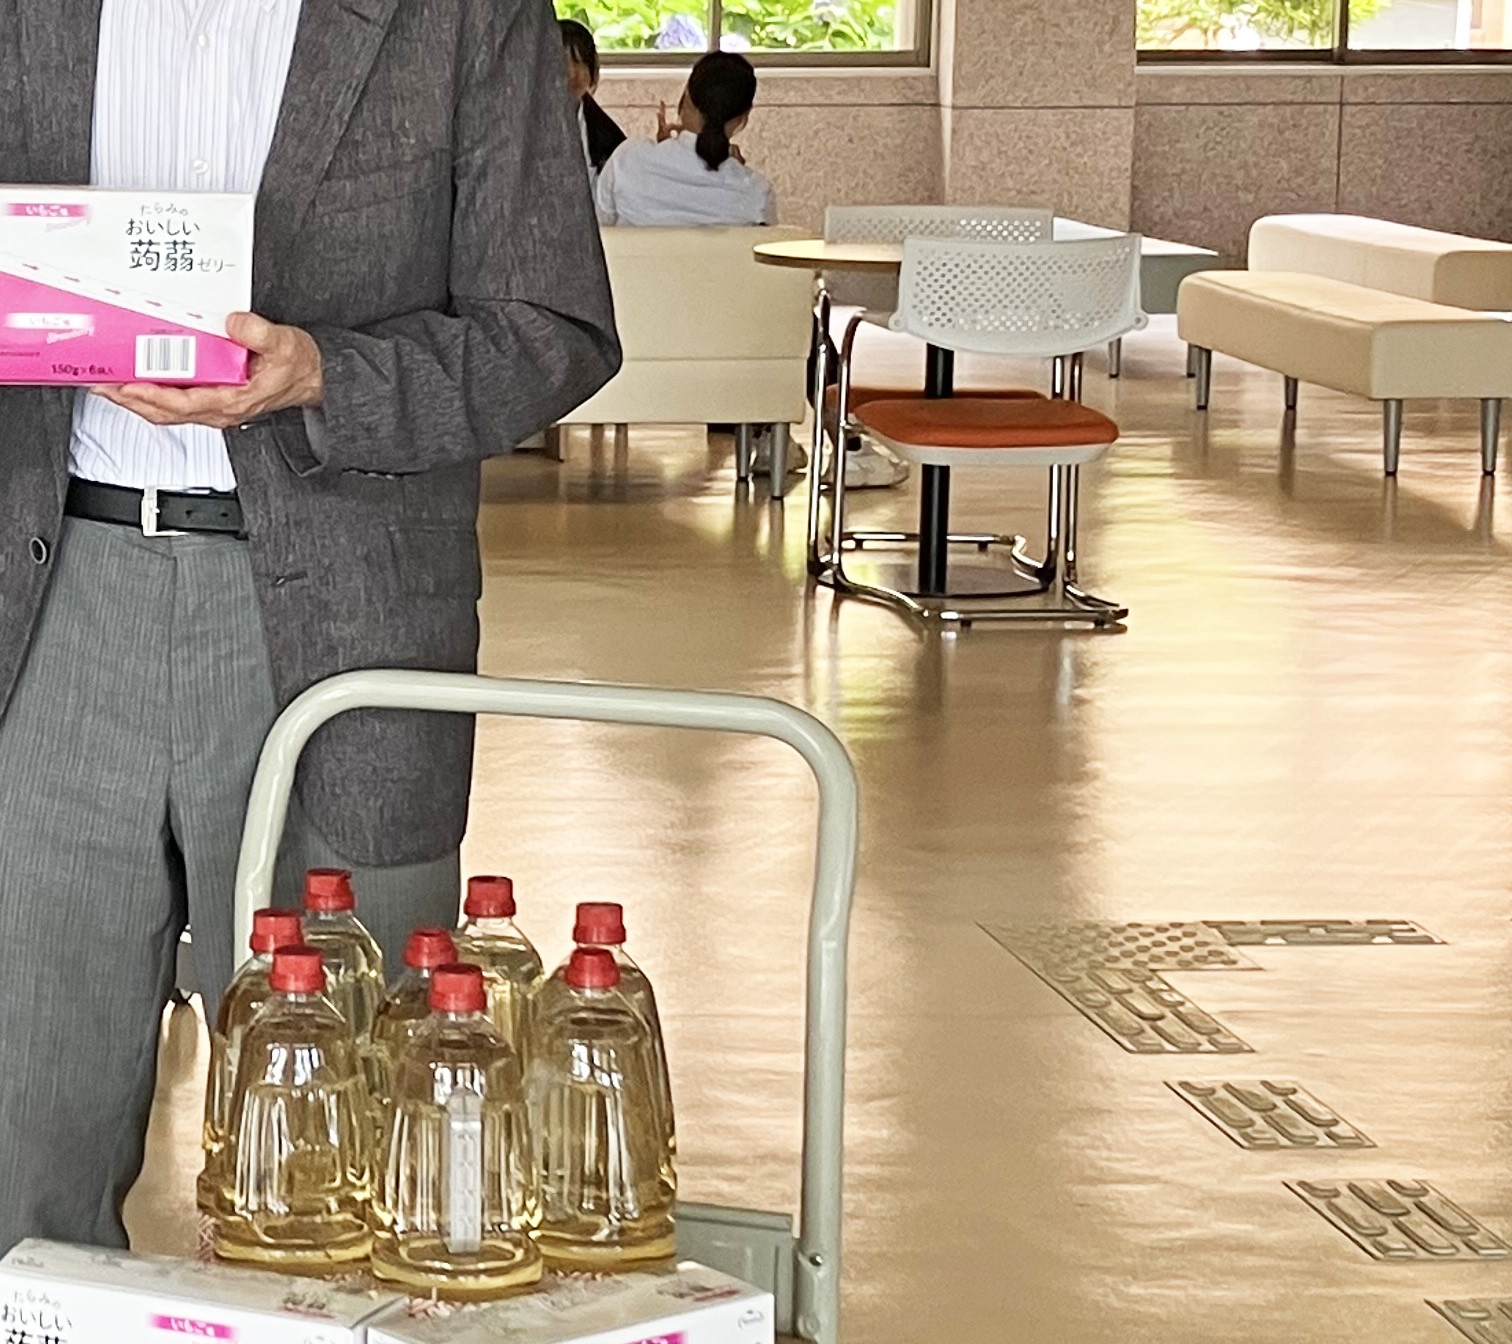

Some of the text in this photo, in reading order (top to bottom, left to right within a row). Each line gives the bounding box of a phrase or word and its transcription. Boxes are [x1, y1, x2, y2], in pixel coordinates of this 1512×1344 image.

[125, 217, 201, 236] おいしい
[197, 257, 238, 274] ゼリー
